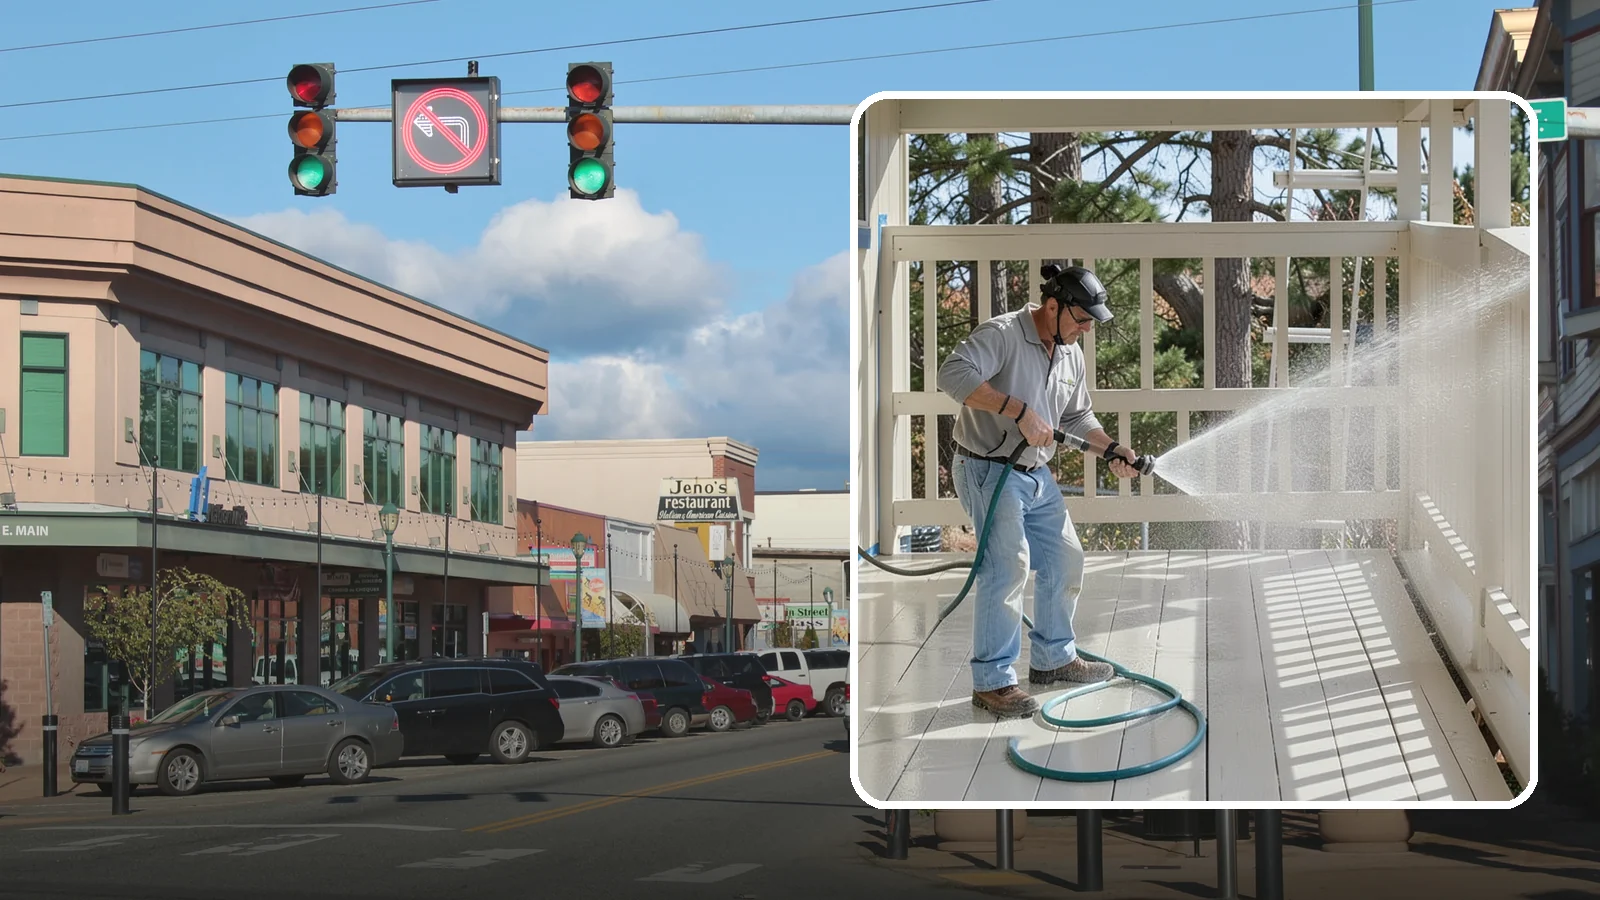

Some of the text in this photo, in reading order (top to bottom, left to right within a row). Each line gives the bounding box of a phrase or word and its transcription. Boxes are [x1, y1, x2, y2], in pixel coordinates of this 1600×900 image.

[670, 480, 727, 494] Jeno's
[665, 496, 731, 508] restaurant
[659, 509, 681, 519] Italian
[686, 509, 714, 519] American
[715, 509, 738, 519] Cuisine
[2, 525, 49, 536] E. MAIN
[797, 607, 828, 617] Street
